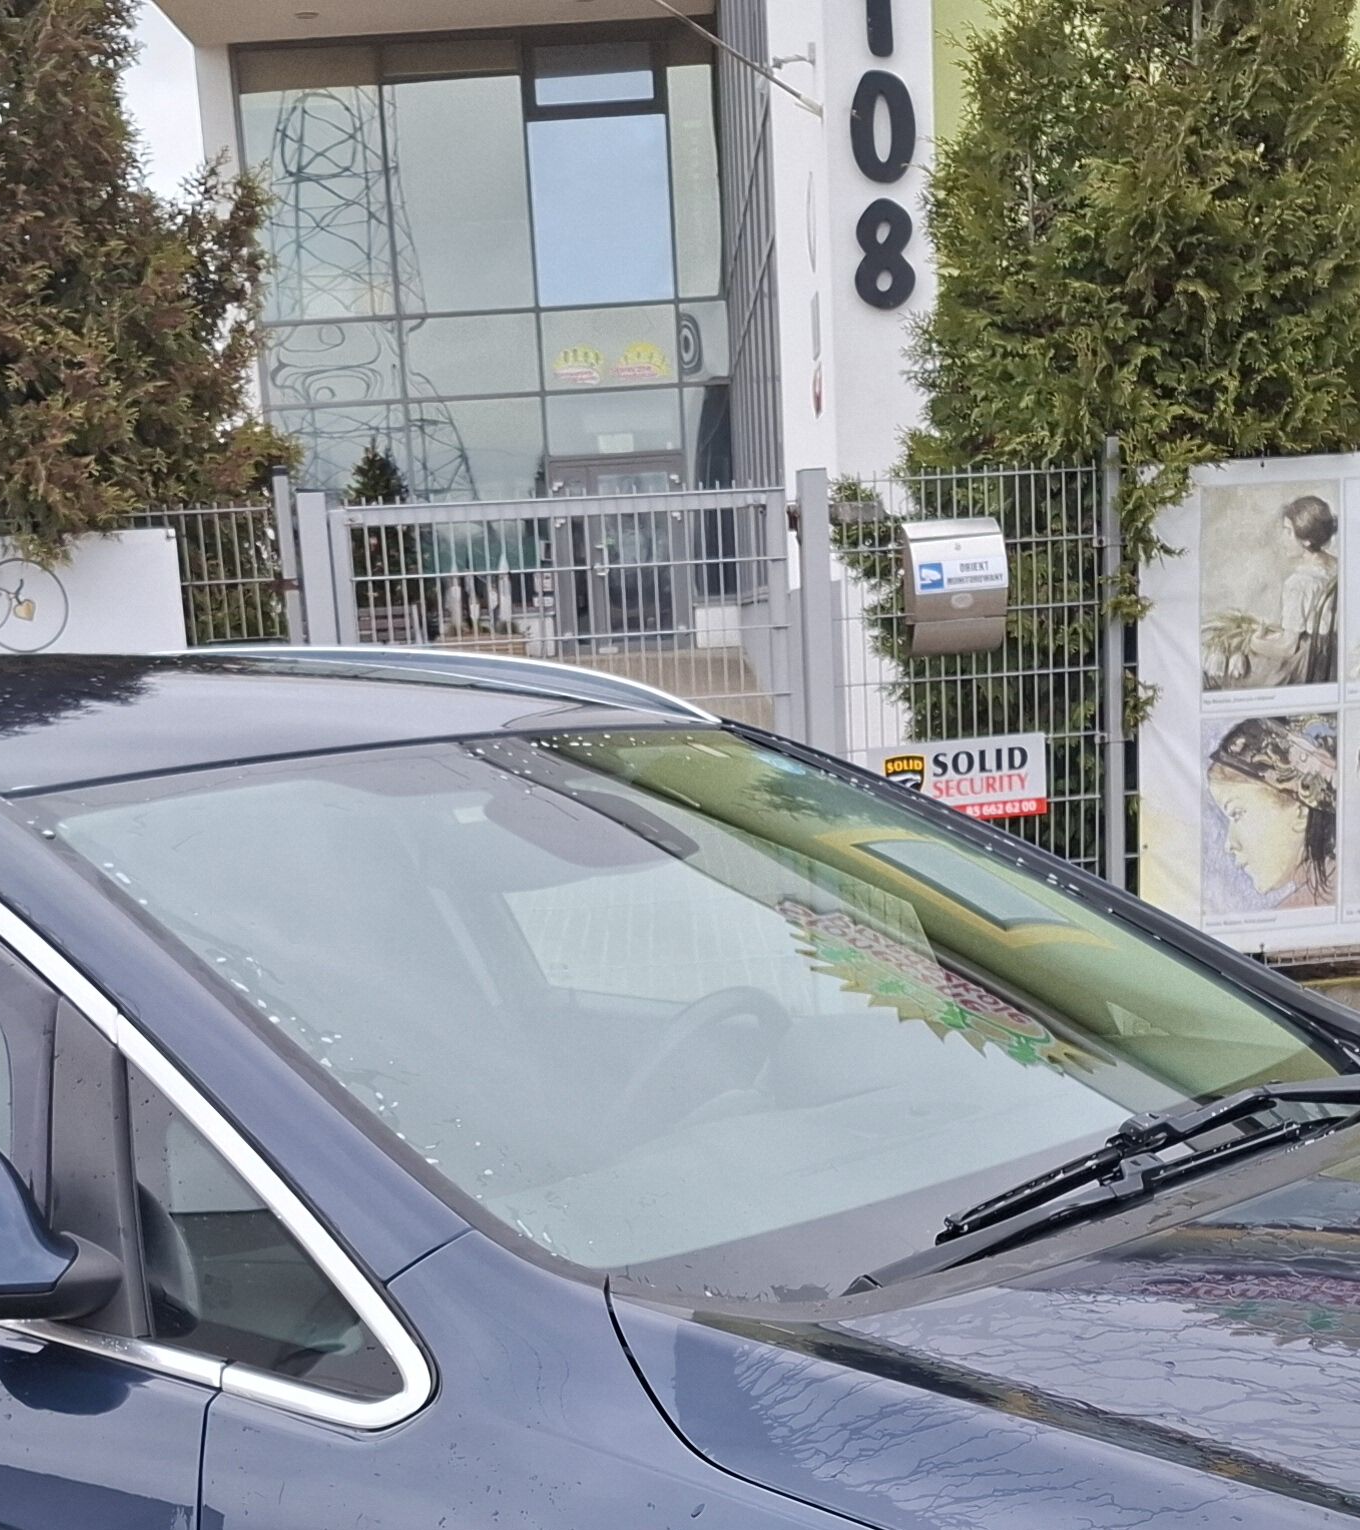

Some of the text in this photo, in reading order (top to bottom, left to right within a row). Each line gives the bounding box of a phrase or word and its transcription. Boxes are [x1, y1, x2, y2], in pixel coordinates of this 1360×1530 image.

[886, 759, 923, 774] SOLID
[932, 745, 1029, 777] SOLID
[932, 773, 1029, 799] SECURITY
[982, 802, 1004, 816] 662
[1005, 801, 1020, 814] 62
[1021, 800, 1037, 812] 00
